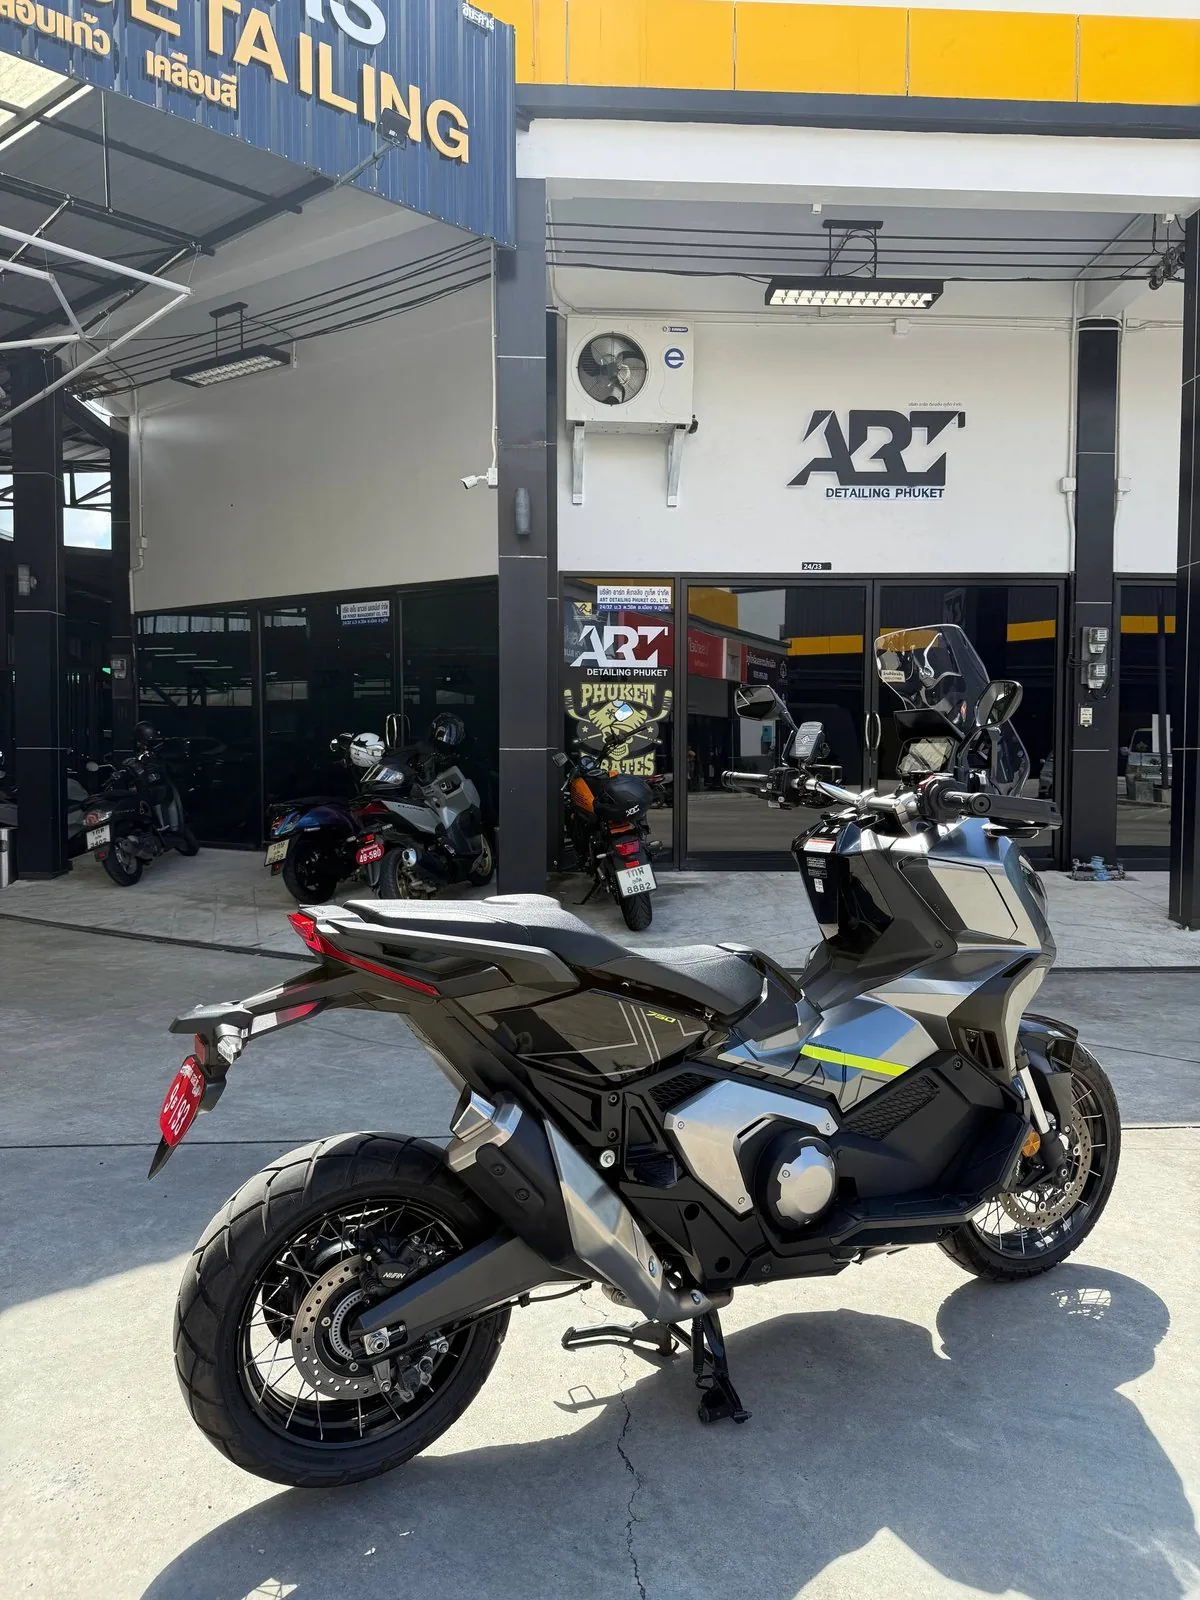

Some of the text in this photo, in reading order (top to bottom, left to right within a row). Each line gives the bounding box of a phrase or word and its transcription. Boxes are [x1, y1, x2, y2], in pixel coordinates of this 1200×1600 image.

[100, 0, 469, 164] ETAILING
[146, 50, 238, 111] เคลือบสี
[786, 410, 966, 486] ART
[826, 488, 945, 498] DETAILING PHUKET
[569, 625, 669, 668] ART
[633, 669, 668, 677] PHUKET
[581, 683, 655, 708] PHUKET
[581, 751, 655, 776] RATES
[627, 882, 652, 894] 8882
[646, 1010, 676, 1023] 750
